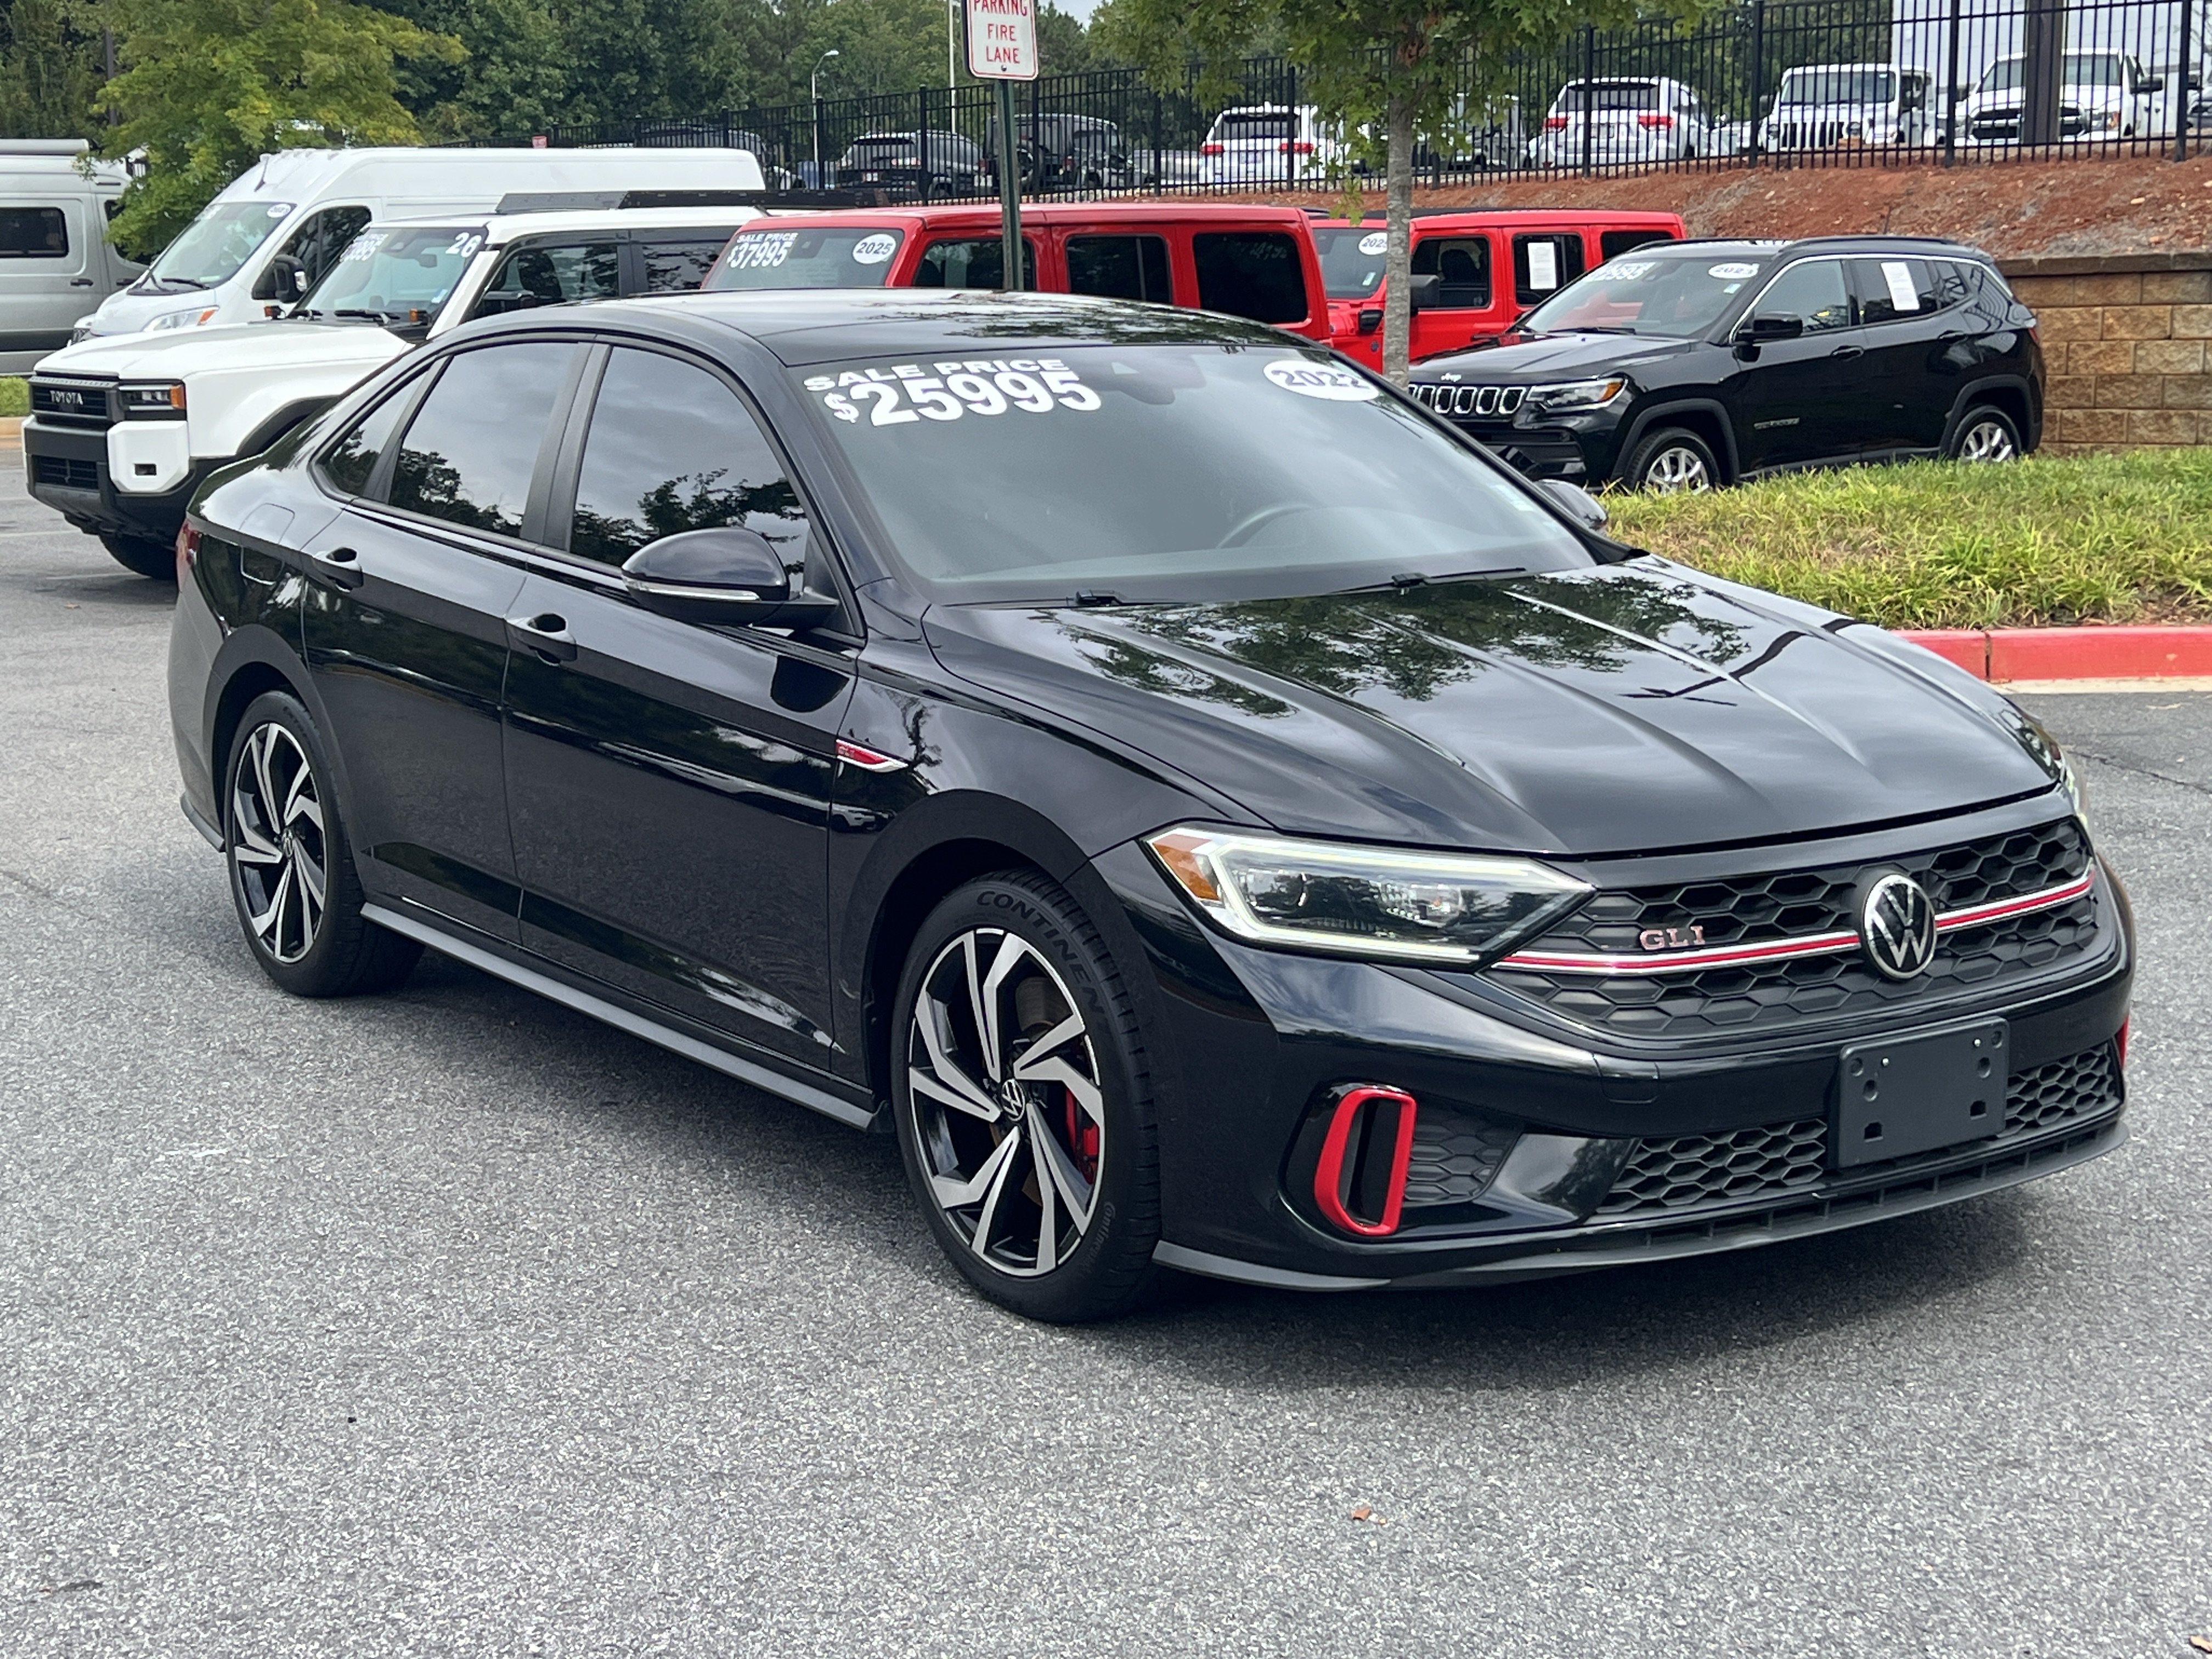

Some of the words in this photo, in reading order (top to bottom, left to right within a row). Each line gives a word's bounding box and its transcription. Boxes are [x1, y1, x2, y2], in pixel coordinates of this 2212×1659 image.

[974, 0, 1028, 16] PARKING
[988, 23, 1017, 41] FIRE
[986, 46, 1020, 64] LANE
[445, 232, 482, 258] 26
[764, 233, 798, 241] PRICE
[726, 241, 793, 269] $37995
[856, 242, 893, 255] 2025
[804, 364, 926, 391] SALE
[933, 359, 1070, 375] PRICE
[1271, 369, 1370, 390] 2022
[49, 390, 83, 405] TOYOTA
[824, 371, 1102, 426] $25995
[1639, 925, 1706, 950] GLI
